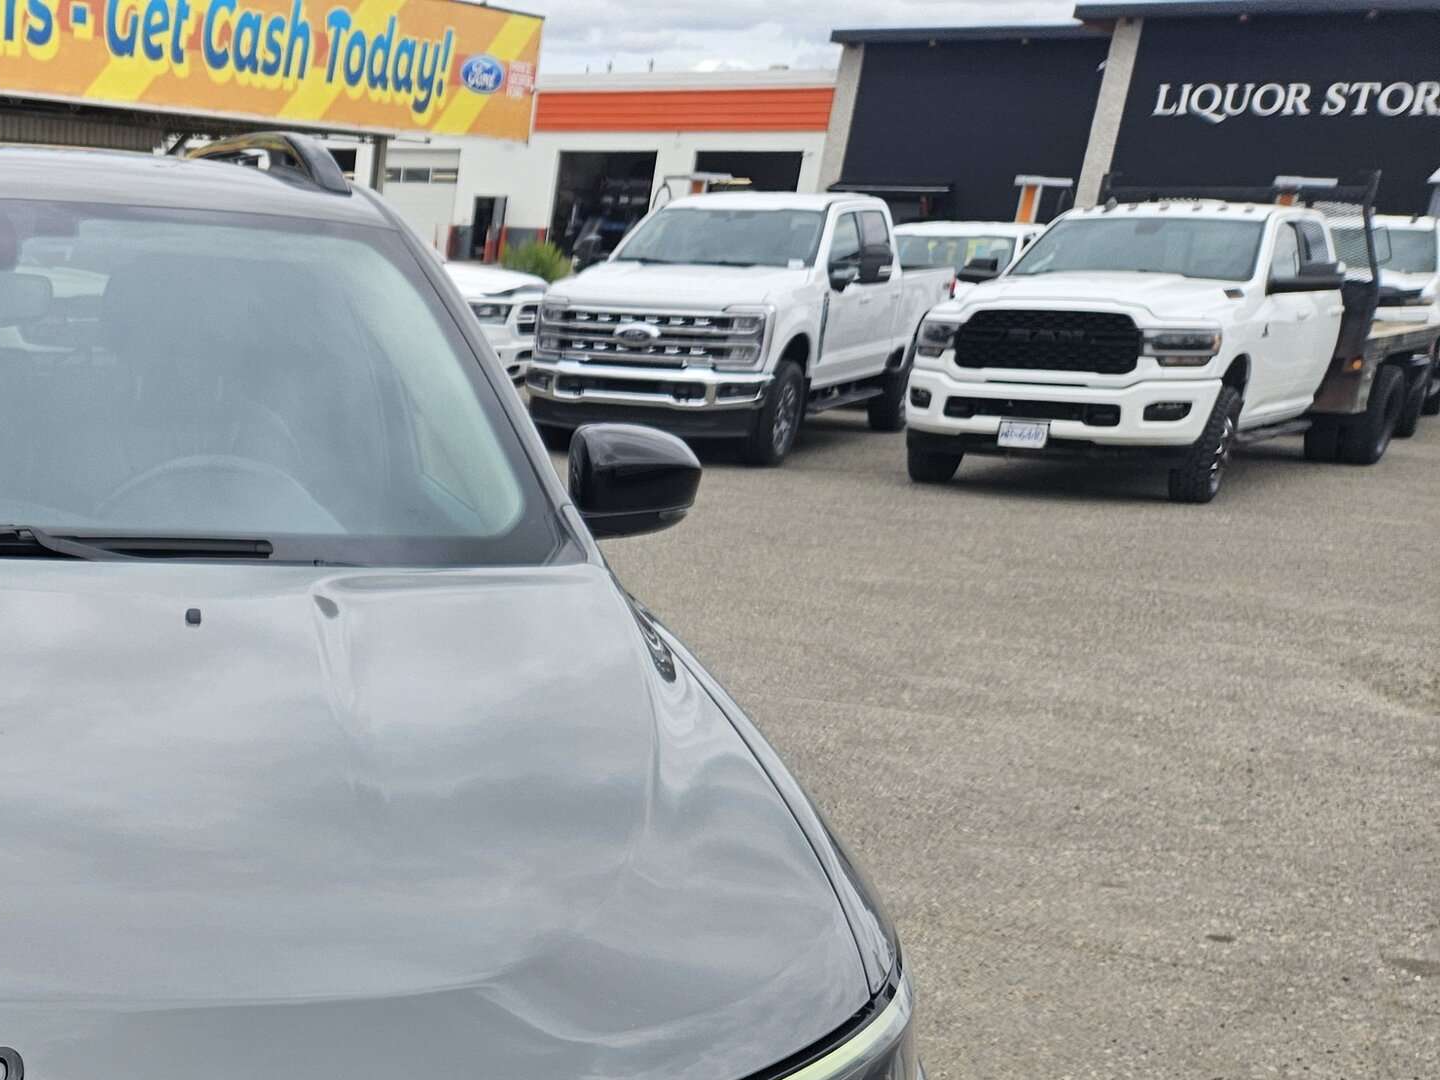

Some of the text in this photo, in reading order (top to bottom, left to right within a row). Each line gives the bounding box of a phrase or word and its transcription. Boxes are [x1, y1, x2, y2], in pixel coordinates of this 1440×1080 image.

[105, 0, 189, 65] Get
[202, 0, 310, 81] Cash
[326, 8, 454, 115] Today!
[1151, 81, 1440, 124] LIQUOR STOR
